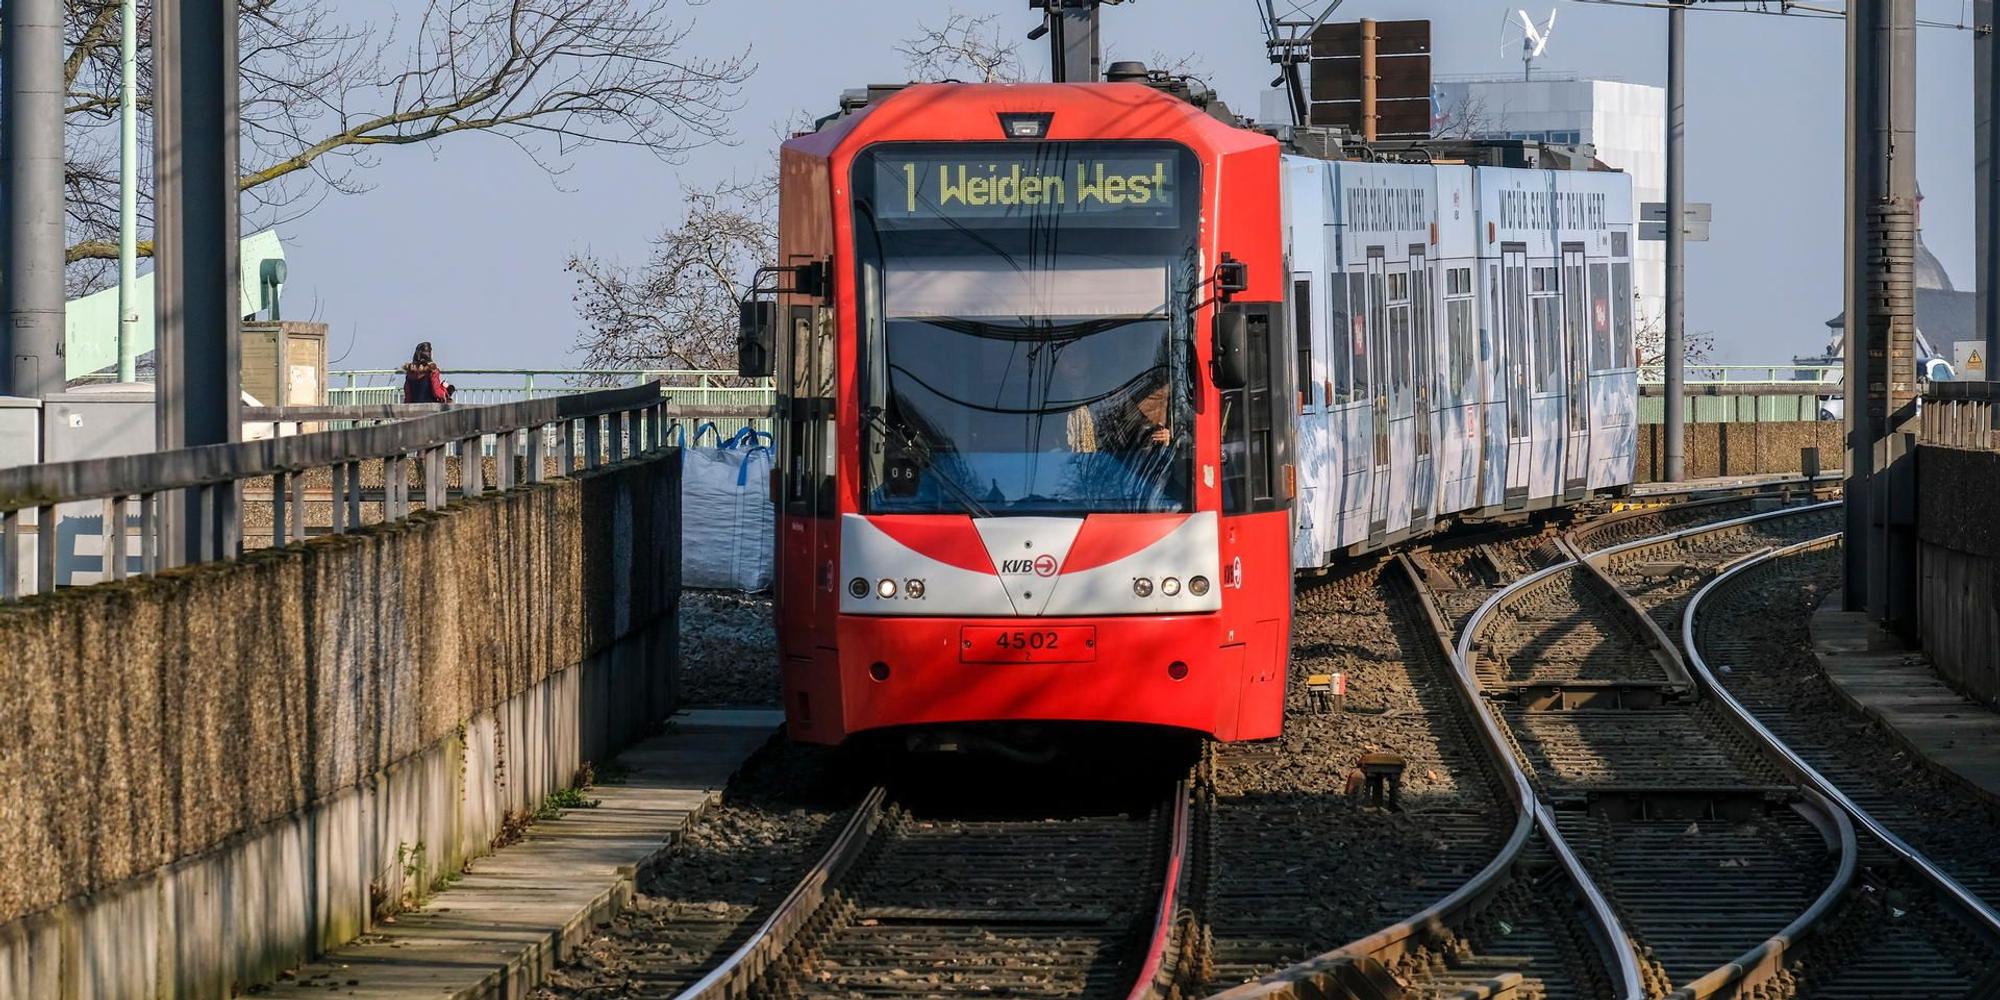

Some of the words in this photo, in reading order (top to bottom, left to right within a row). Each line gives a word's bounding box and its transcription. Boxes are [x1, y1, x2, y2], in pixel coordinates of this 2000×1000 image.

[903, 162, 915, 212] 1
[940, 163, 1065, 206] Weiden
[1078, 163, 1168, 205] West
[1499, 180, 1528, 230] WOFÜR
[1566, 191, 1585, 230] DEIN
[1587, 191, 1606, 230] HERZ
[1002, 559, 1034, 573] KVB
[996, 631, 1059, 649] 4502
